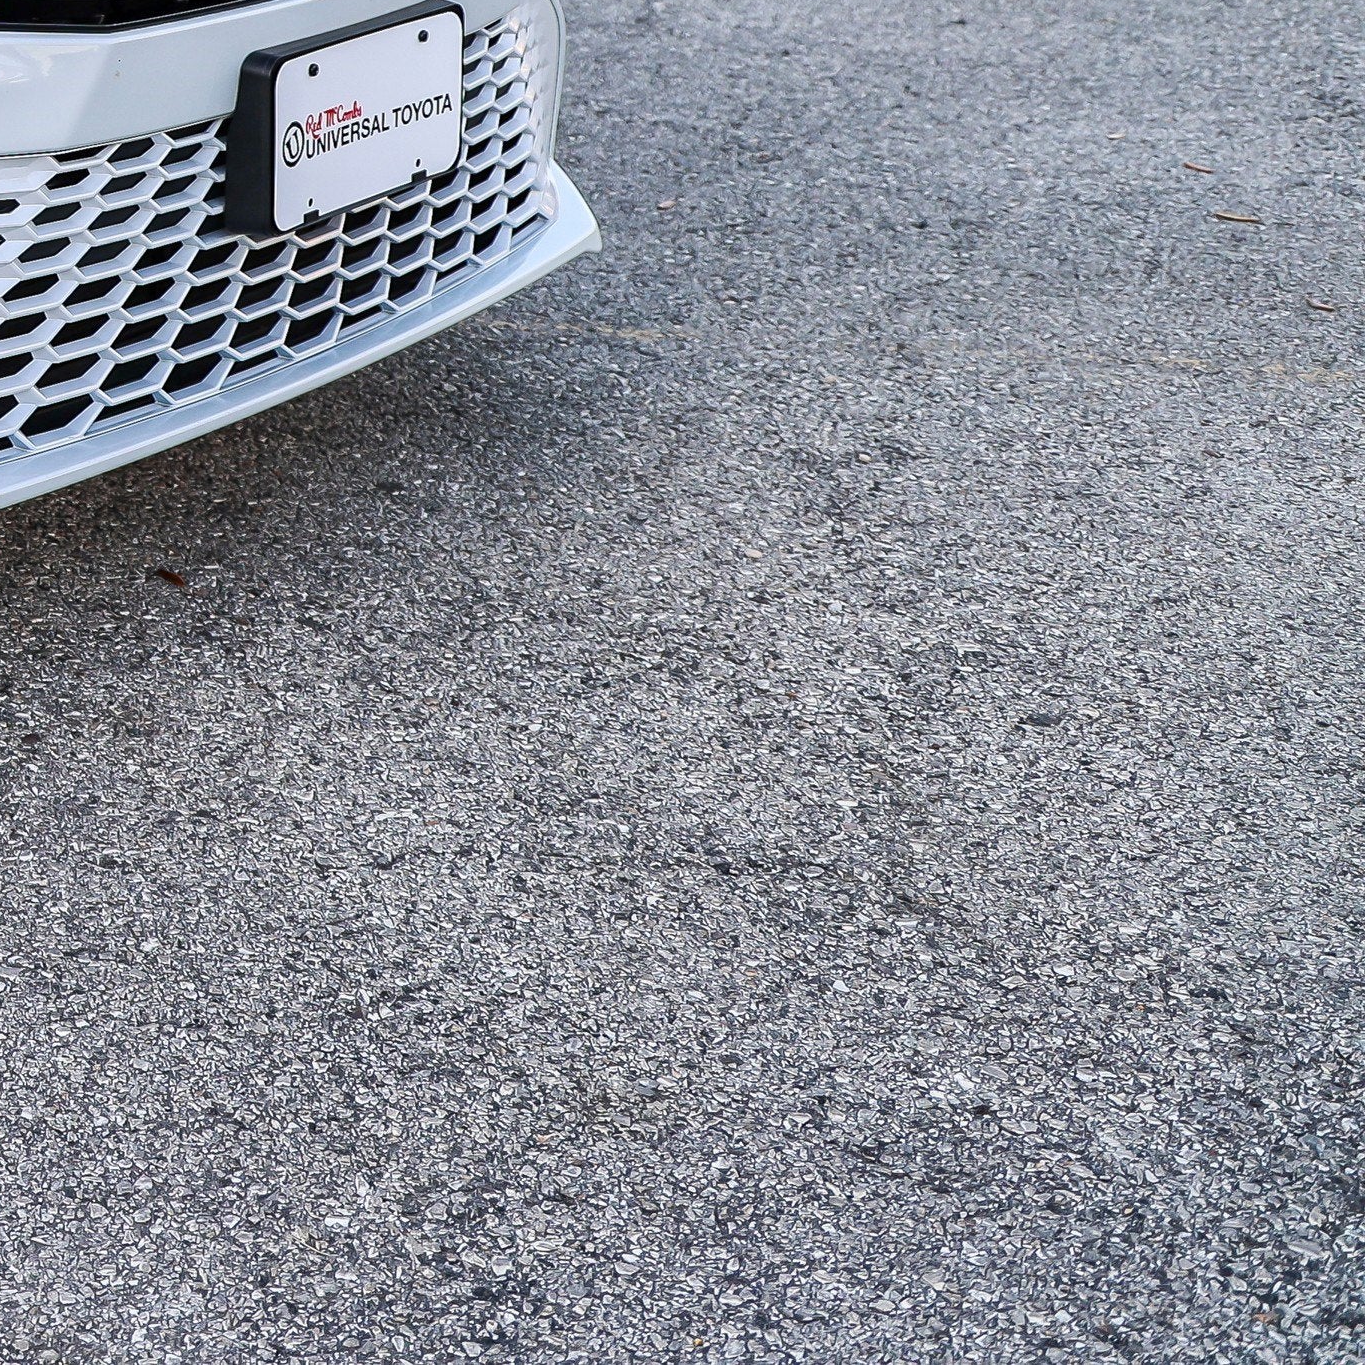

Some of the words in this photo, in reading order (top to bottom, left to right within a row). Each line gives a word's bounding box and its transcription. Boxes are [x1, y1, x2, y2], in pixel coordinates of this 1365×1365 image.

[306, 113, 323, 139] Red
[306, 112, 390, 159] UNIVERSAL
[392, 93, 453, 128] TOYOTA
